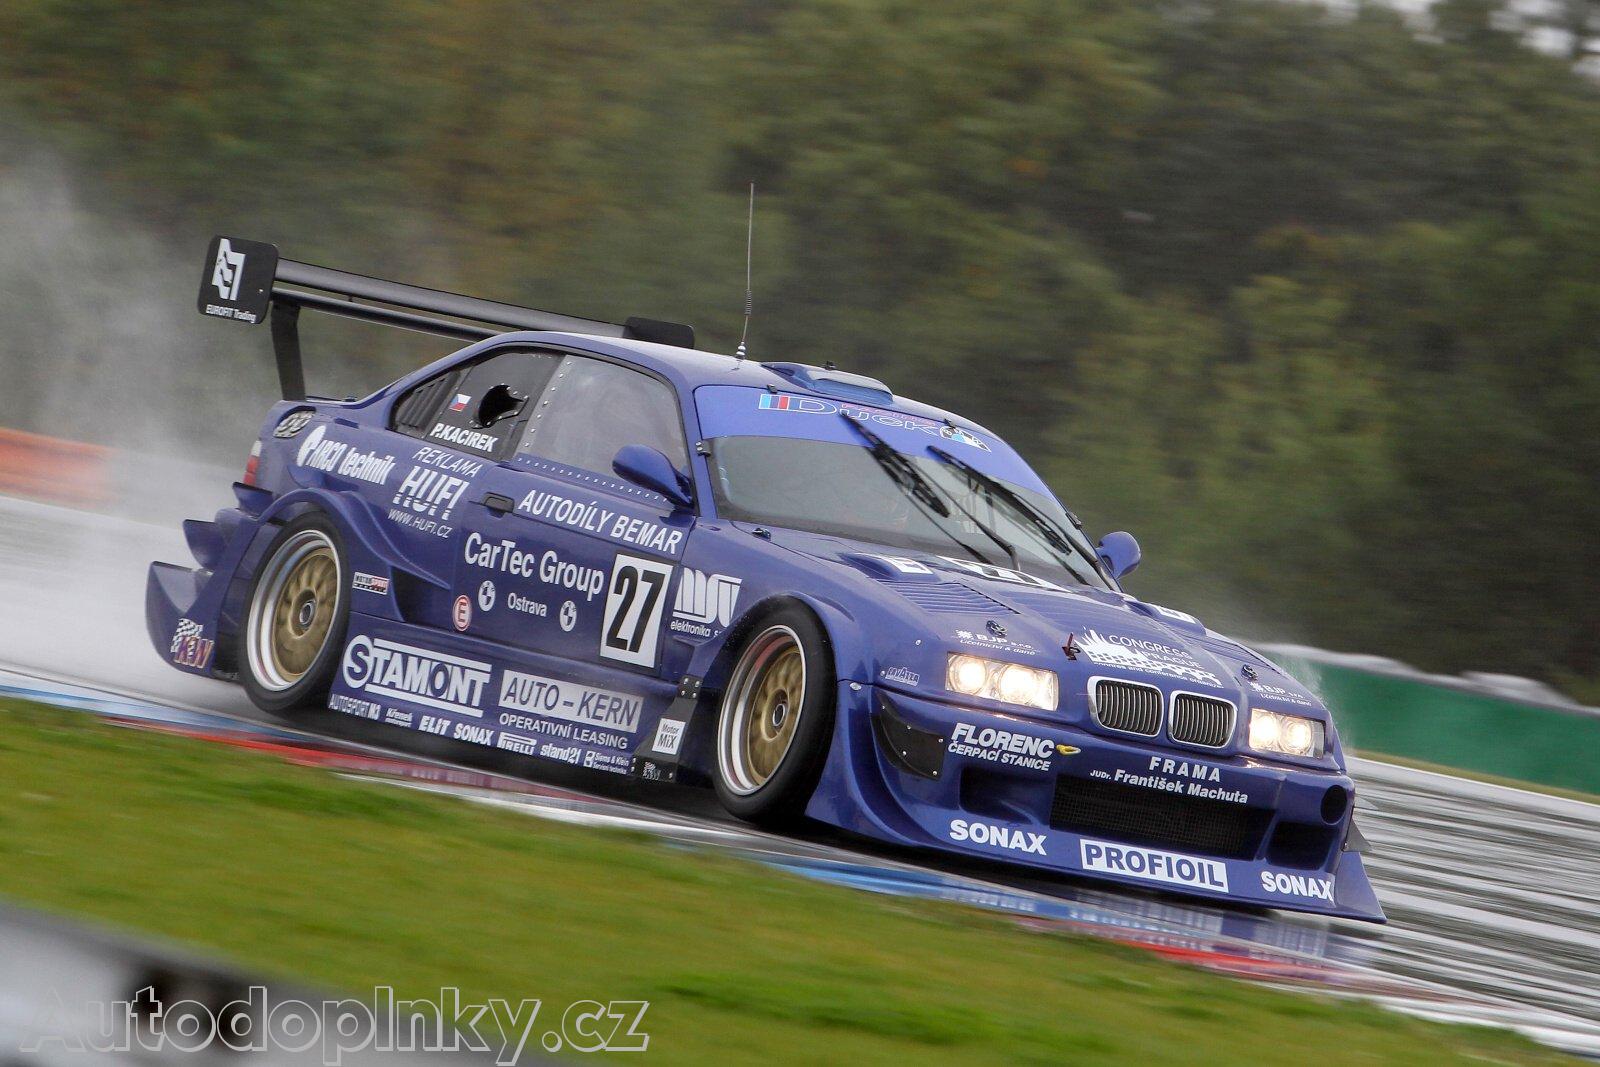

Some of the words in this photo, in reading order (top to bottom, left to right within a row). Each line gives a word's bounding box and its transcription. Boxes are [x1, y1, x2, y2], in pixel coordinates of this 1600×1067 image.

[429, 423, 499, 454] P.KACIREK
[338, 447, 397, 485] technik
[412, 447, 483, 478] REKLAMA
[517, 489, 614, 533] AUTODÍLY
[610, 515, 683, 554] BEMAR
[464, 532, 535, 578] CarTec
[539, 551, 604, 601] Group
[507, 592, 547, 618] Ostrava
[606, 565, 667, 653] 27
[670, 620, 711, 637] elektronika
[1108, 635, 1193, 660] CONGRESS
[1142, 651, 1205, 669] PRAGUE
[343, 635, 491, 707] STAMONT
[503, 677, 560, 711] AUTO
[577, 691, 639, 727] KERN
[454, 722, 495, 747] SONAX
[497, 731, 537, 756] PIRELLI
[499, 712, 572, 739] OPERATIVNÍ
[572, 727, 628, 750] LEASING
[951, 722, 1055, 759] FLORENC
[540, 742, 582, 765] stand21
[948, 740, 1002, 762] ČERPACÍ
[1001, 753, 1052, 771] STANICE
[1149, 756, 1221, 783] FRAMA
[1114, 769, 1184, 794] František
[1187, 782, 1249, 804] Machuta
[950, 819, 1047, 856] SONAX
[1084, 843, 1225, 888] PROFIOIL
[1261, 870, 1335, 903] SONAX
